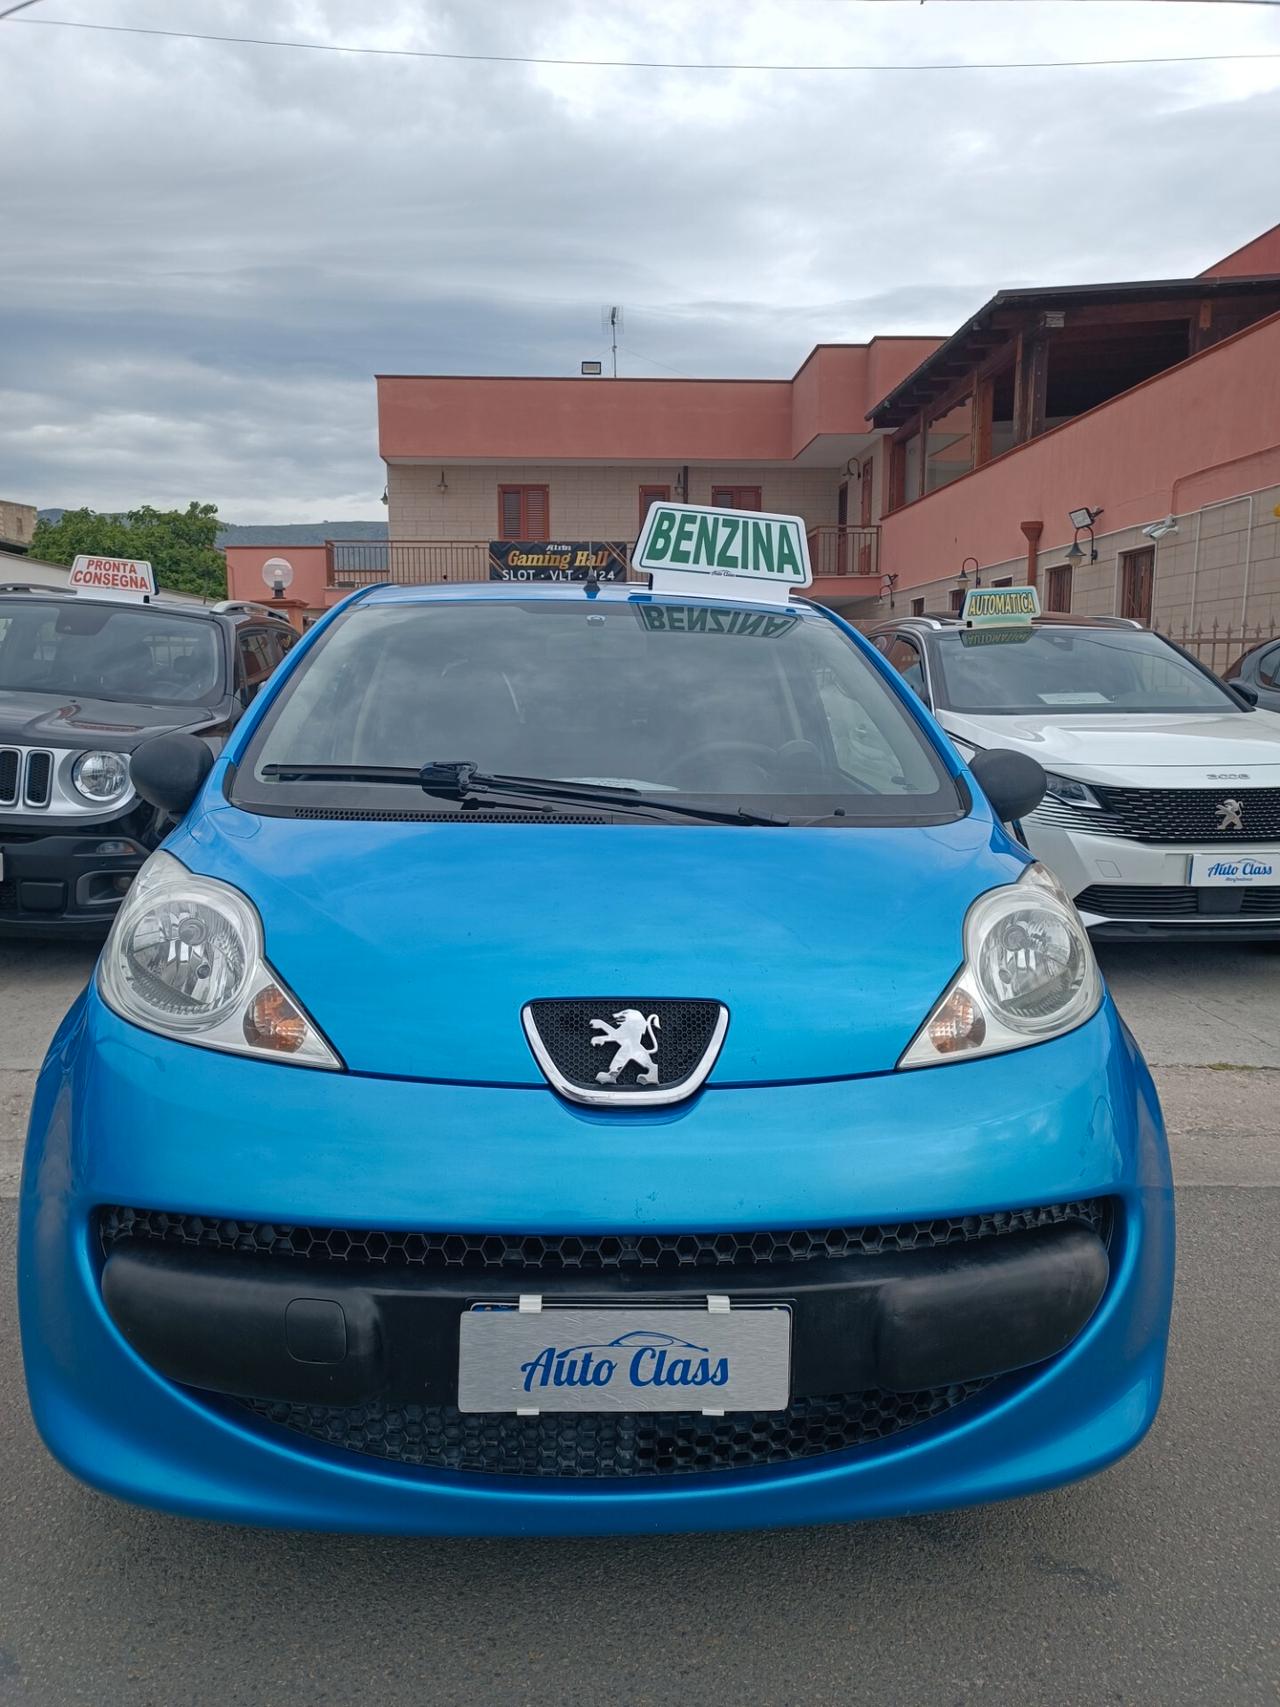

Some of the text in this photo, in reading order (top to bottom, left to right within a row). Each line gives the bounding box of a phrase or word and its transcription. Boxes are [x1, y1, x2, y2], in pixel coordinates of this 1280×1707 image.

[645, 511, 802, 576] BENZINA
[86, 559, 138, 575] PRONTA
[508, 550, 609, 569] Gaming Hall
[73, 570, 149, 590] CONSEGNA
[502, 570, 536, 581] SLOT
[549, 570, 574, 581] VLT
[967, 592, 1037, 617] AUTOMATICA
[1207, 862, 1273, 877] Auto Class
[520, 1346, 729, 1392] Auto Class
